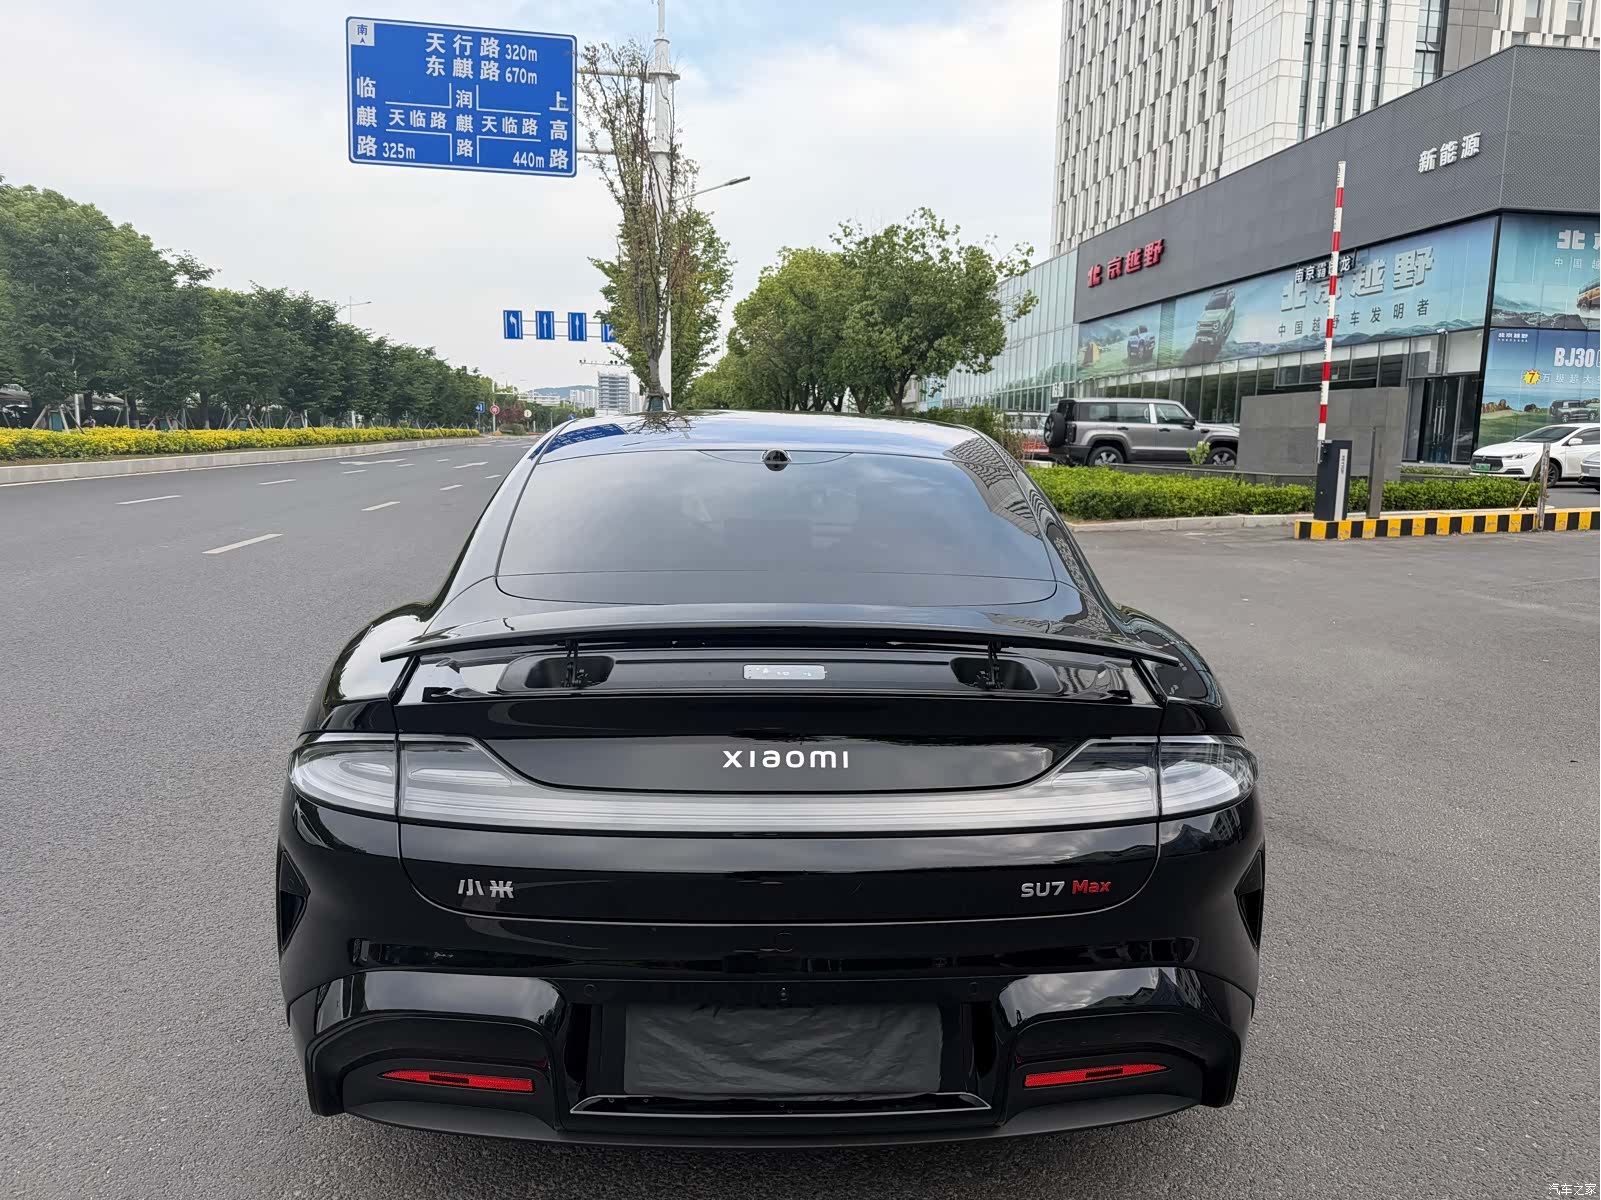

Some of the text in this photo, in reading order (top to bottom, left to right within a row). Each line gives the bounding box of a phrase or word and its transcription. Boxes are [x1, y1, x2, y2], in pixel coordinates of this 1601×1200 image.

[357, 23, 368, 35] 南
[425, 32, 538, 62] 天行路 320m
[425, 55, 538, 85] 东麒路 670m
[356, 76, 378, 158] 临麒路
[388, 108, 448, 130] 天临路
[456, 89, 474, 158] 润麒路
[481, 115, 539, 137] 天临路
[549, 91, 569, 170] 上高路
[382, 142, 416, 160] 325m
[513, 151, 545, 169] 440m
[1418, 132, 1481, 173] 新能源
[1556, 229, 1600, 251] 北
[1087, 239, 1165, 288] 北京越野
[1295, 256, 1352, 283] 南京霸龙
[1553, 347, 1596, 368] BJ30
[458, 879, 514, 898] 小米
[1021, 880, 1111, 898] SU7 Max
